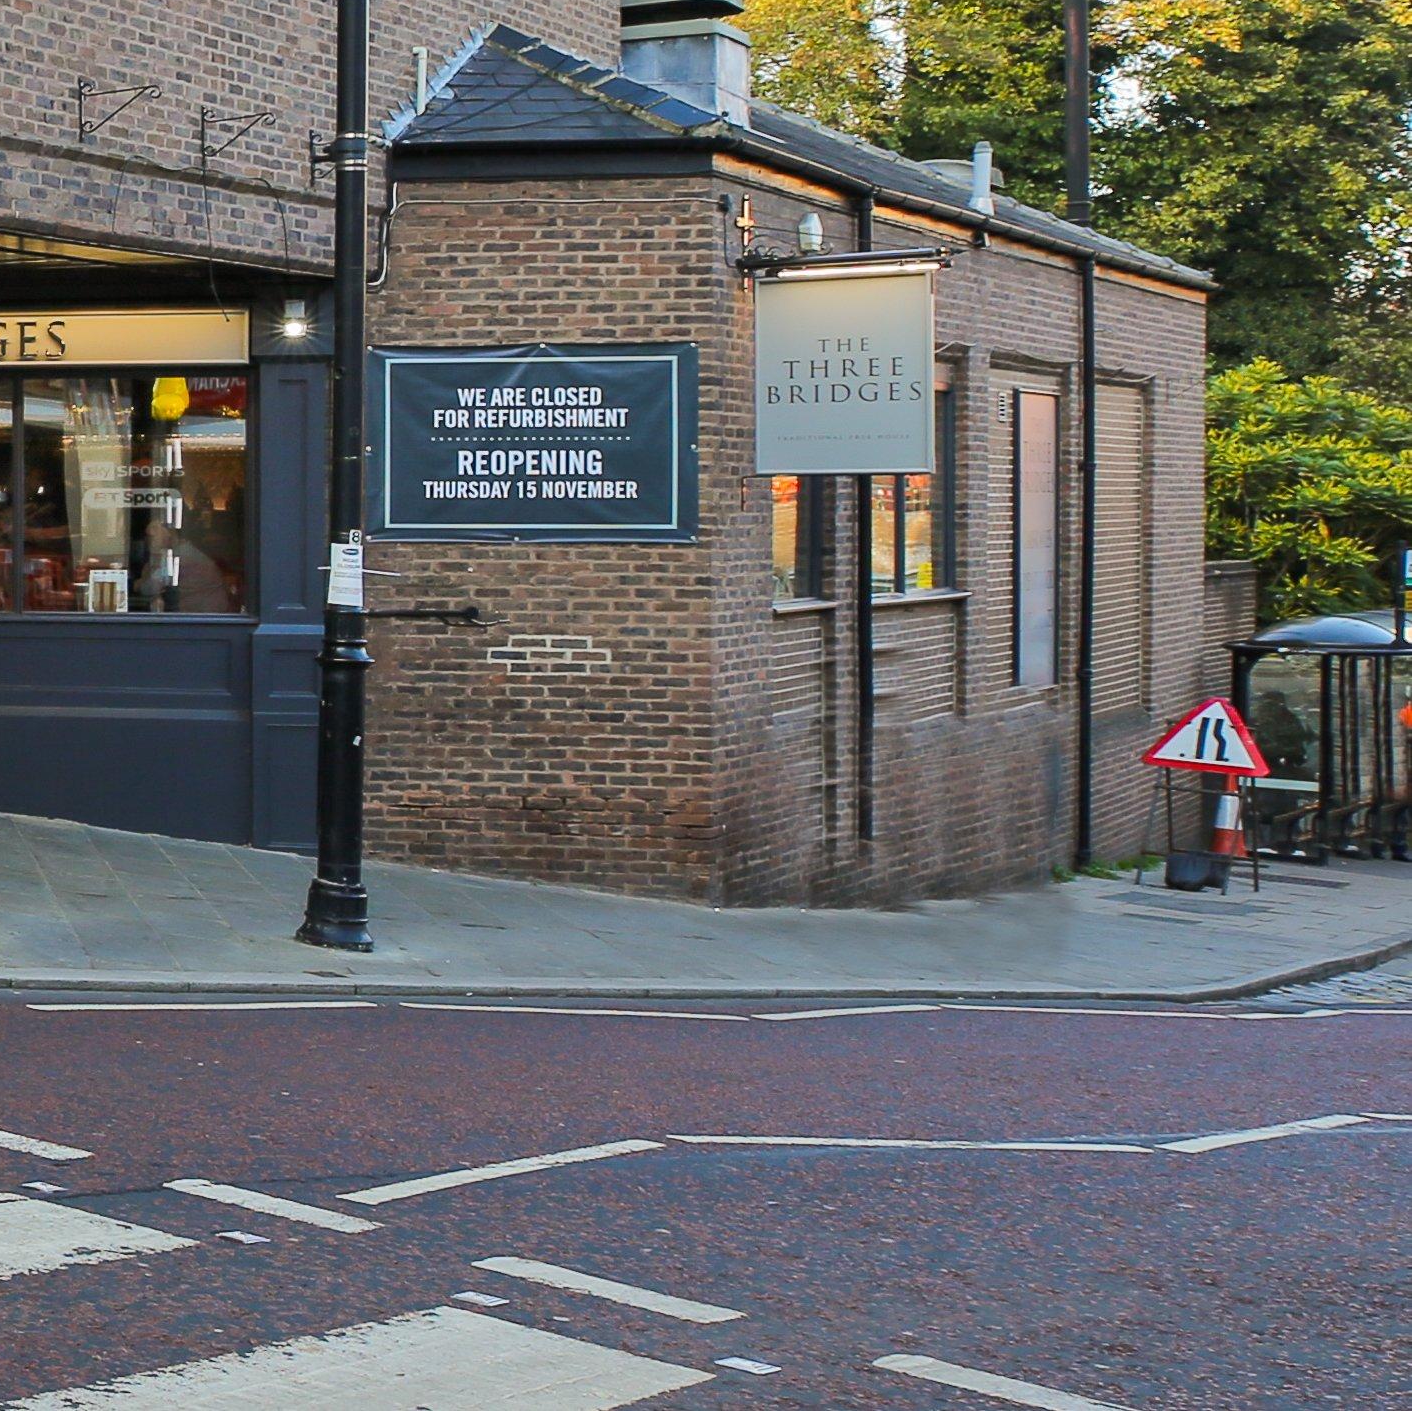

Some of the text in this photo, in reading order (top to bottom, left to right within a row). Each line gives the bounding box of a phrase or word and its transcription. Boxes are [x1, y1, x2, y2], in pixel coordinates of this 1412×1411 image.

[818, 337, 870, 353] THE
[783, 357, 903, 379] THREE
[457, 387, 602, 407] WE ARE CLOSED
[767, 381, 922, 404] BRIDGES
[433, 408, 629, 428] FOR REFURBISHMENT
[117, 464, 185, 478] SPORTS
[458, 450, 603, 476] REOPENING
[123, 489, 170, 505] Sport
[423, 480, 638, 499] THURSDAY 15 NOVEMBER
[351, 531, 360, 543] 8
